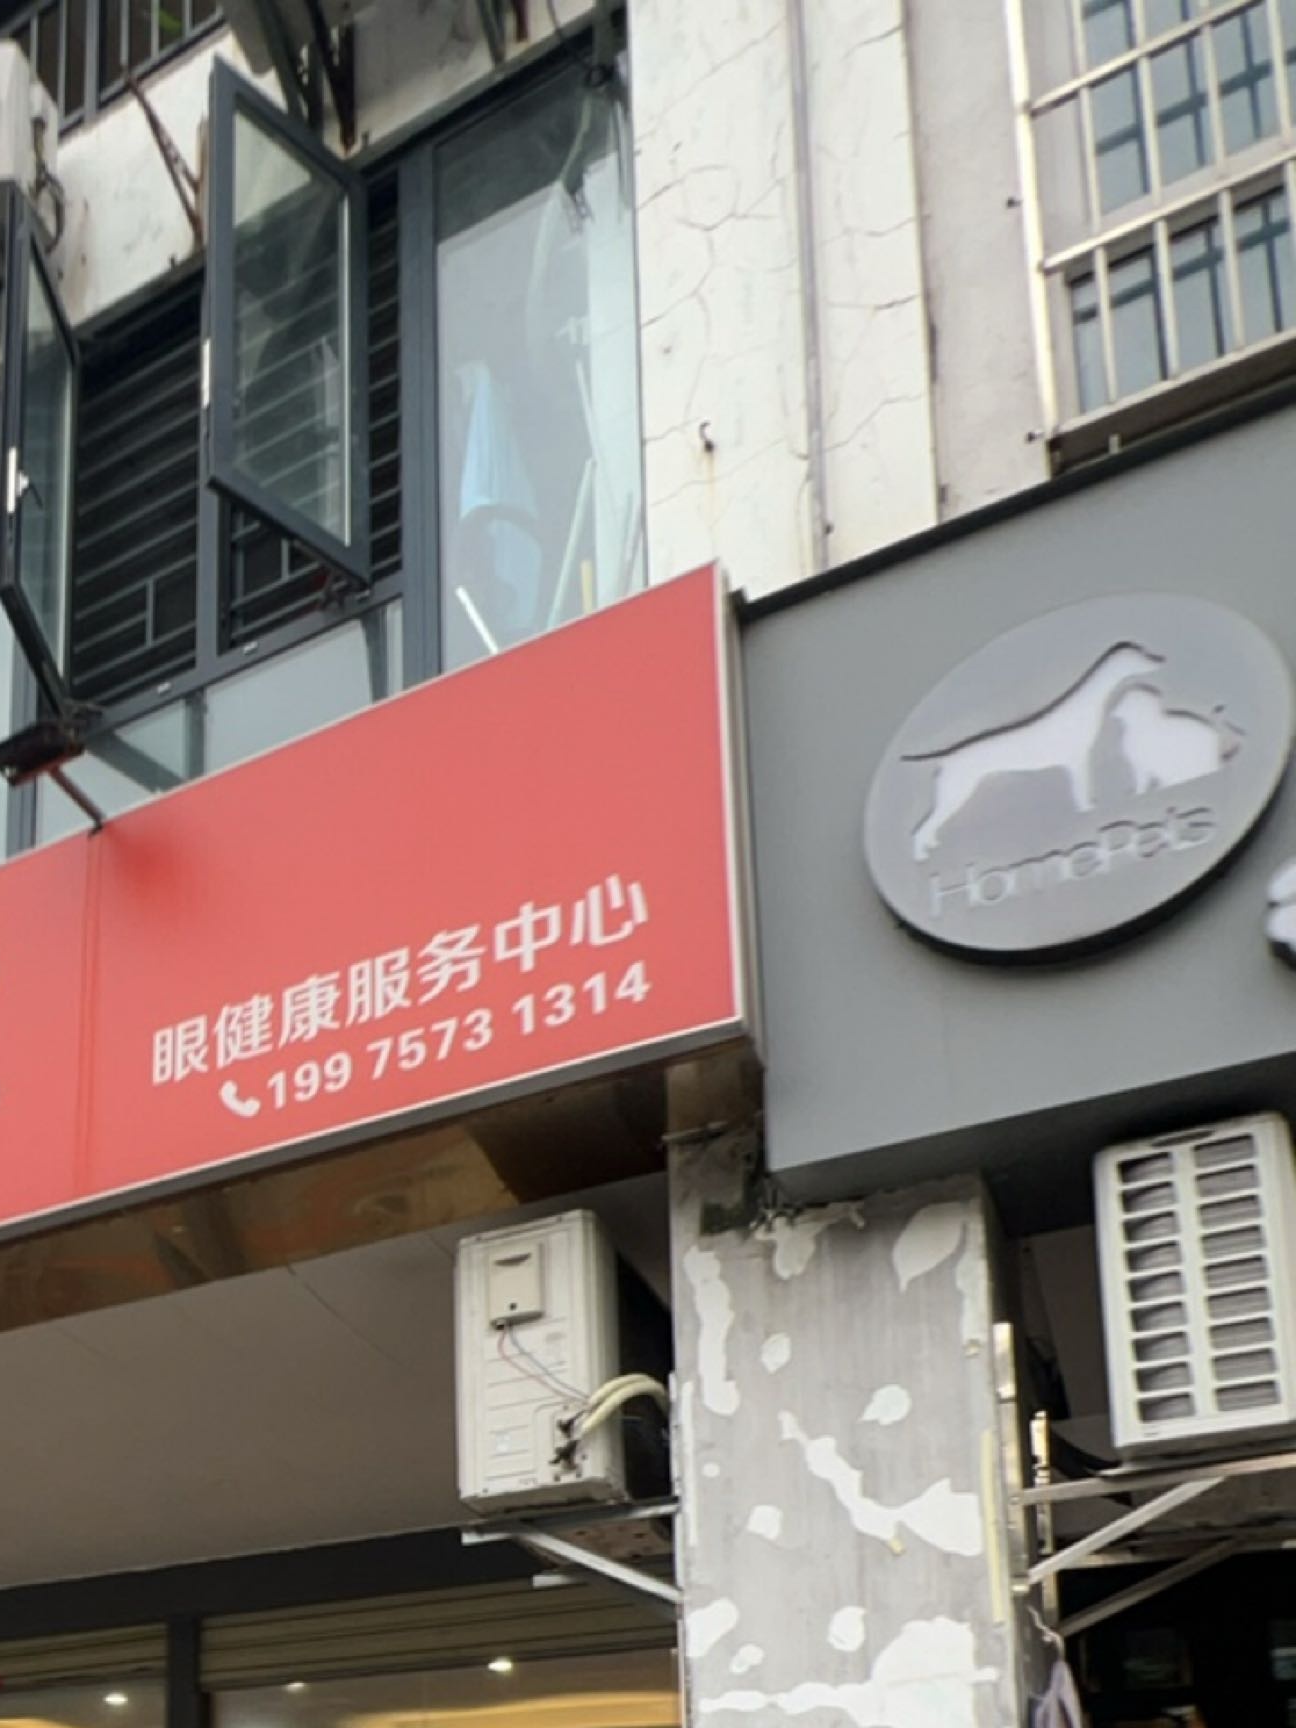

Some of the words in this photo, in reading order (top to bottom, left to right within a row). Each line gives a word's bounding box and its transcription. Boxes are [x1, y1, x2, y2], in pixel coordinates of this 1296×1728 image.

[152, 873, 650, 1086] 眼健康服务中心
[266, 1051, 353, 1110] 199
[366, 1008, 495, 1080] 7573
[510, 960, 653, 1036] 1314
